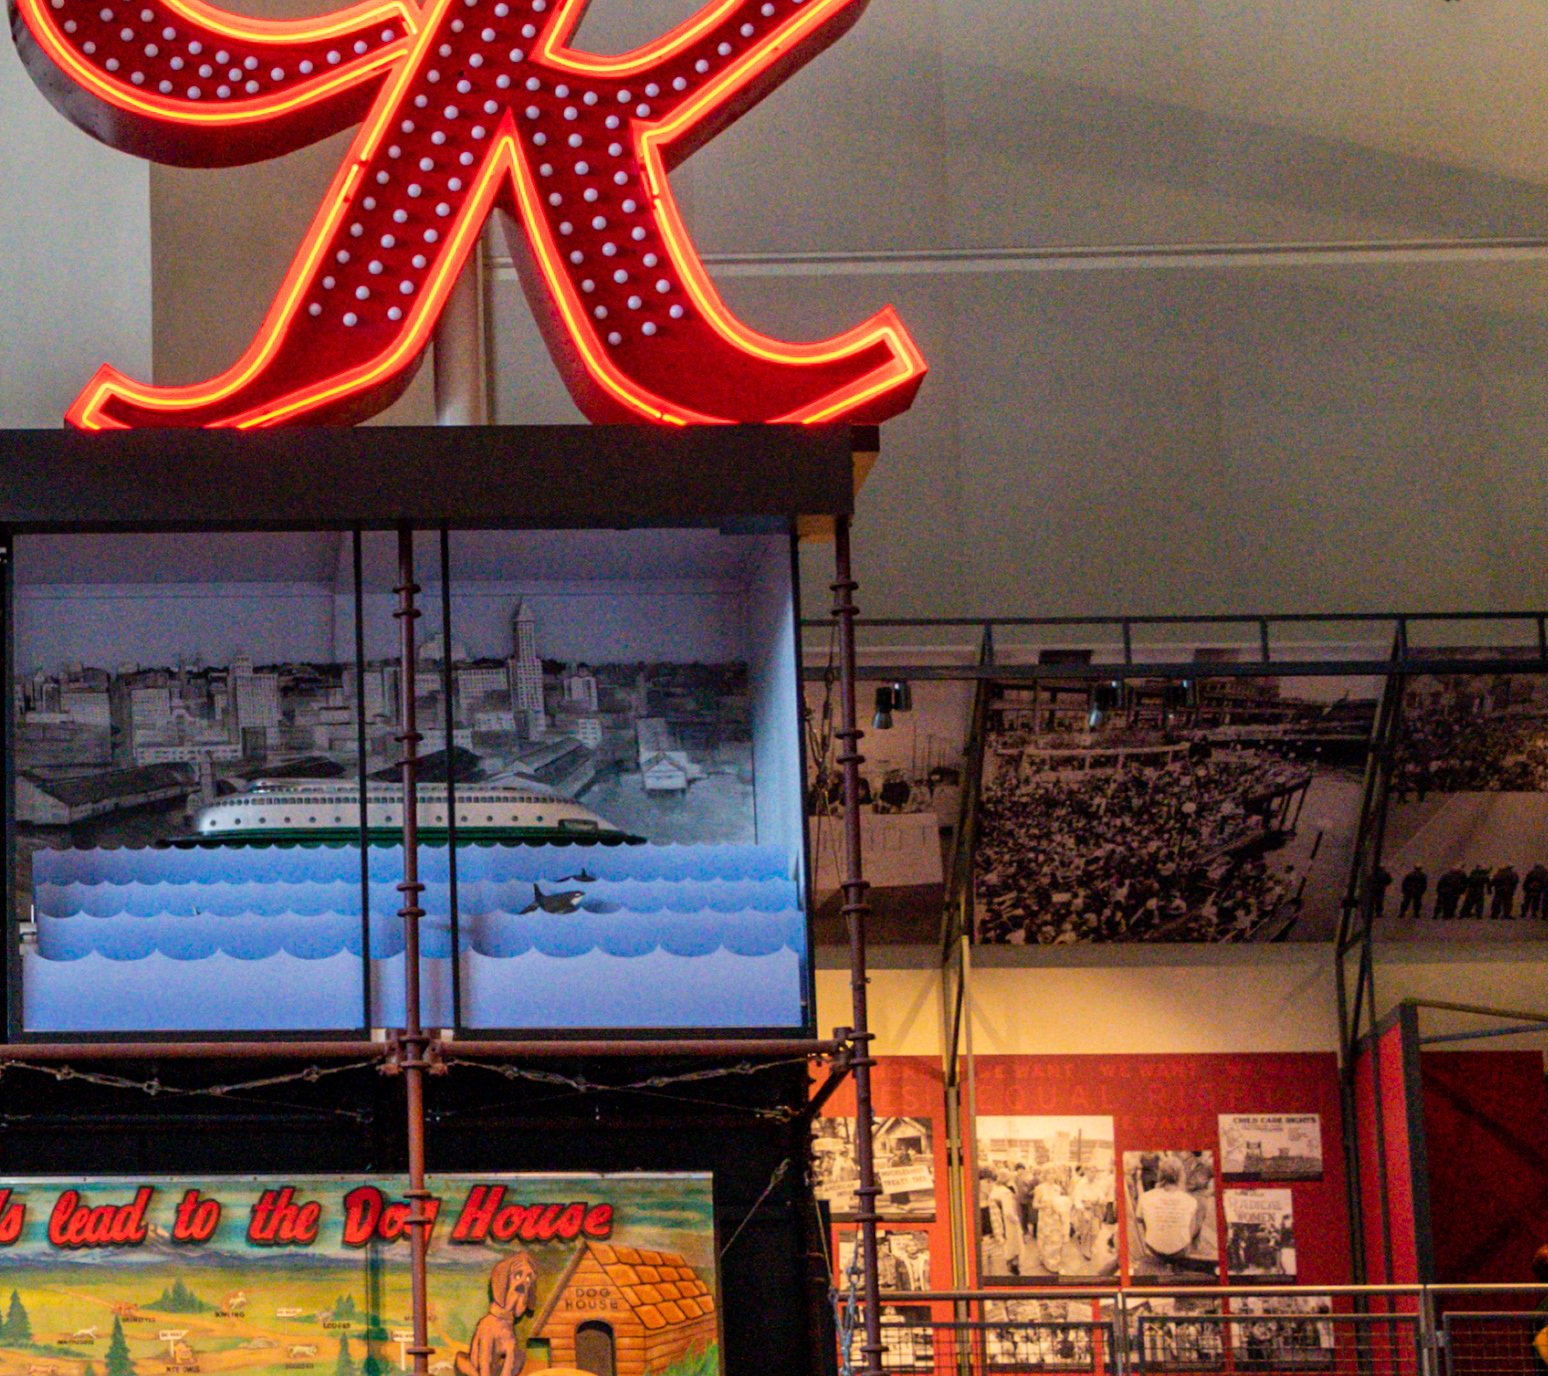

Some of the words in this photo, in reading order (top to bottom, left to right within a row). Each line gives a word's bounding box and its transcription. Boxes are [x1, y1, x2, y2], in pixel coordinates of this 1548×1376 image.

[48, 1185, 154, 1249] lead
[172, 1189, 221, 1245] to
[245, 1185, 321, 1246] the
[450, 1185, 613, 1245] House
[575, 1288, 611, 1298] DOG
[565, 1299, 618, 1310] HOUSE
